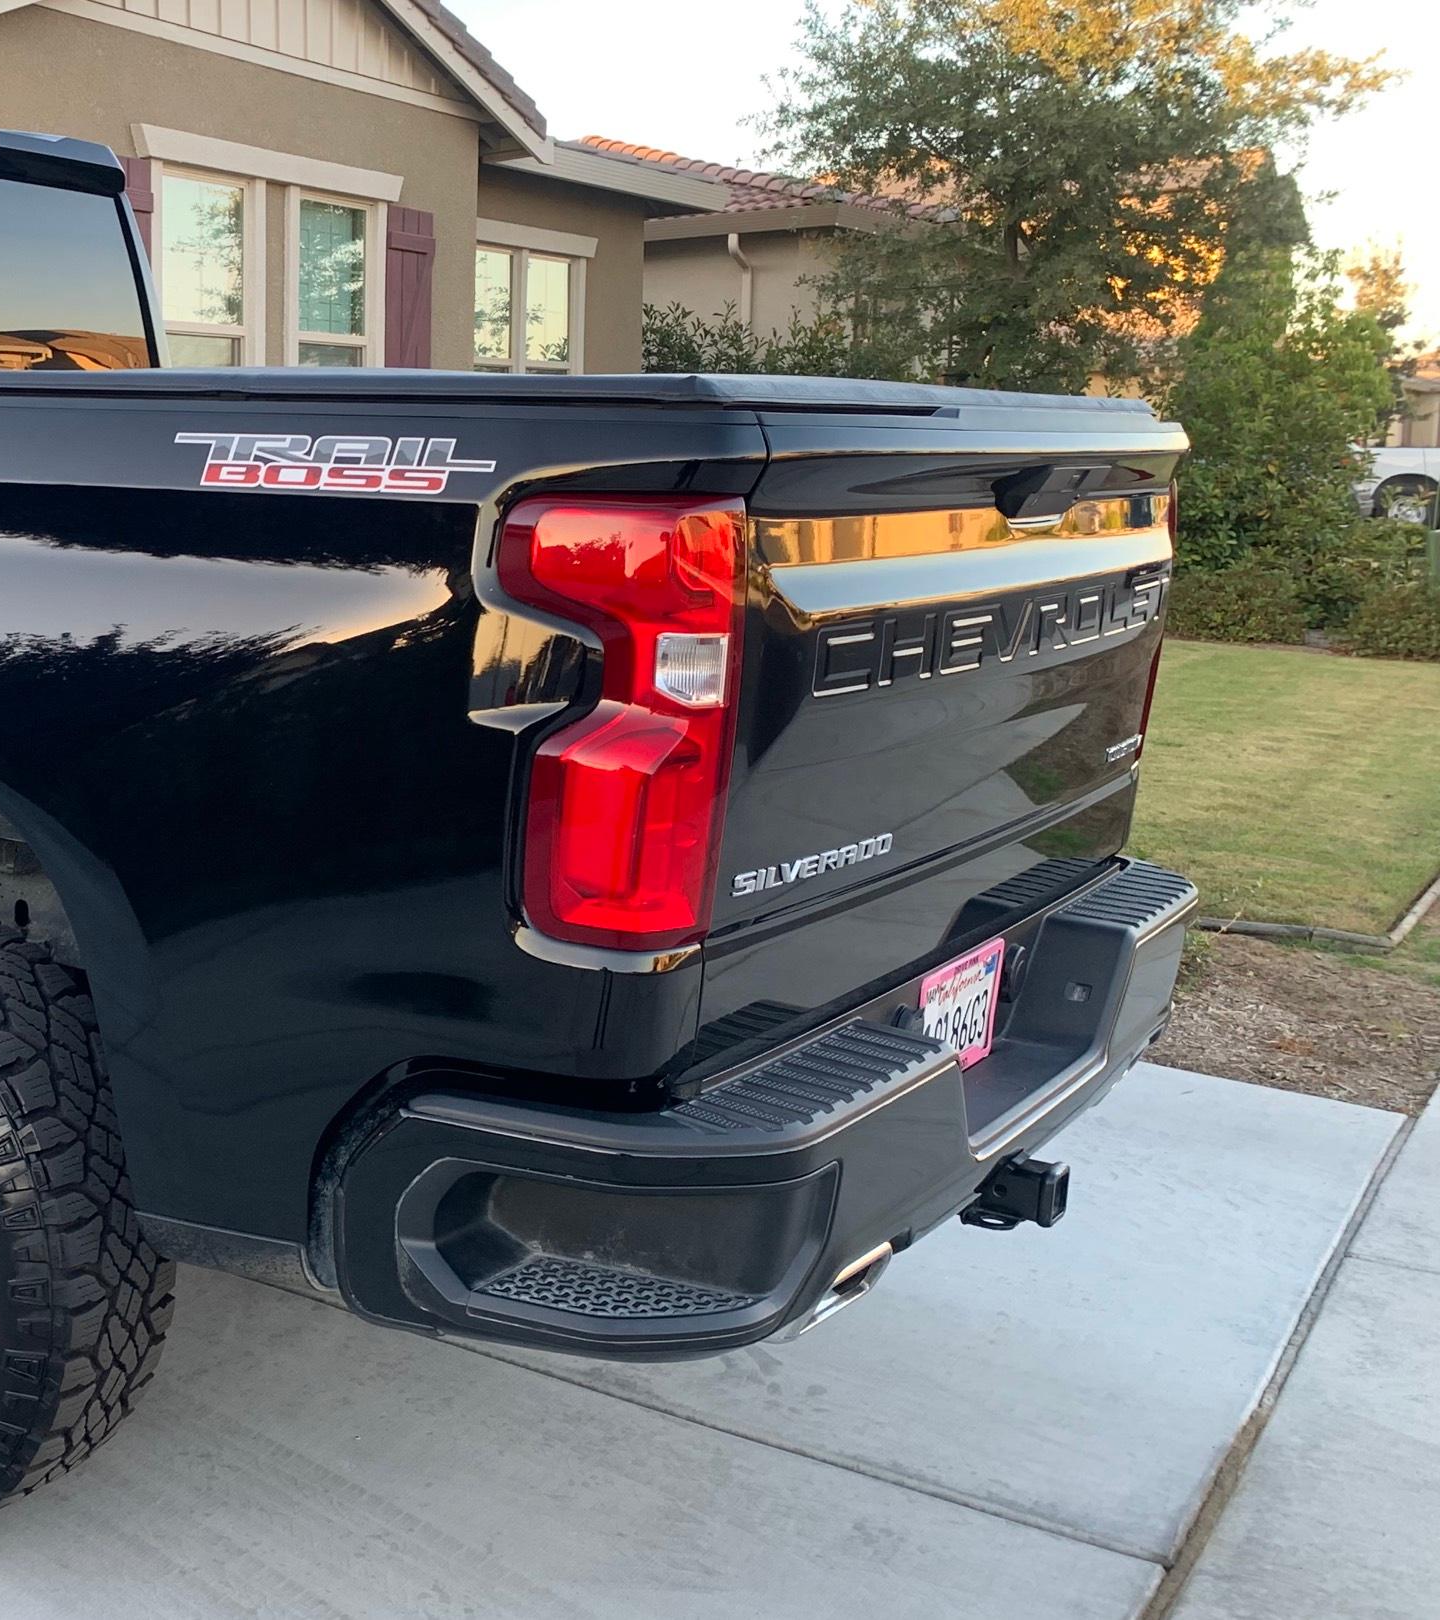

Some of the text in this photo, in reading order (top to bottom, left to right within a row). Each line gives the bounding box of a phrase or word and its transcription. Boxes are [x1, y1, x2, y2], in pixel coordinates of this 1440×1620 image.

[174, 433, 497, 473] TRAIL
[200, 461, 449, 495] BOSS
[812, 568, 1170, 698] CHEVROLET
[731, 832, 893, 897] SILVERADO
